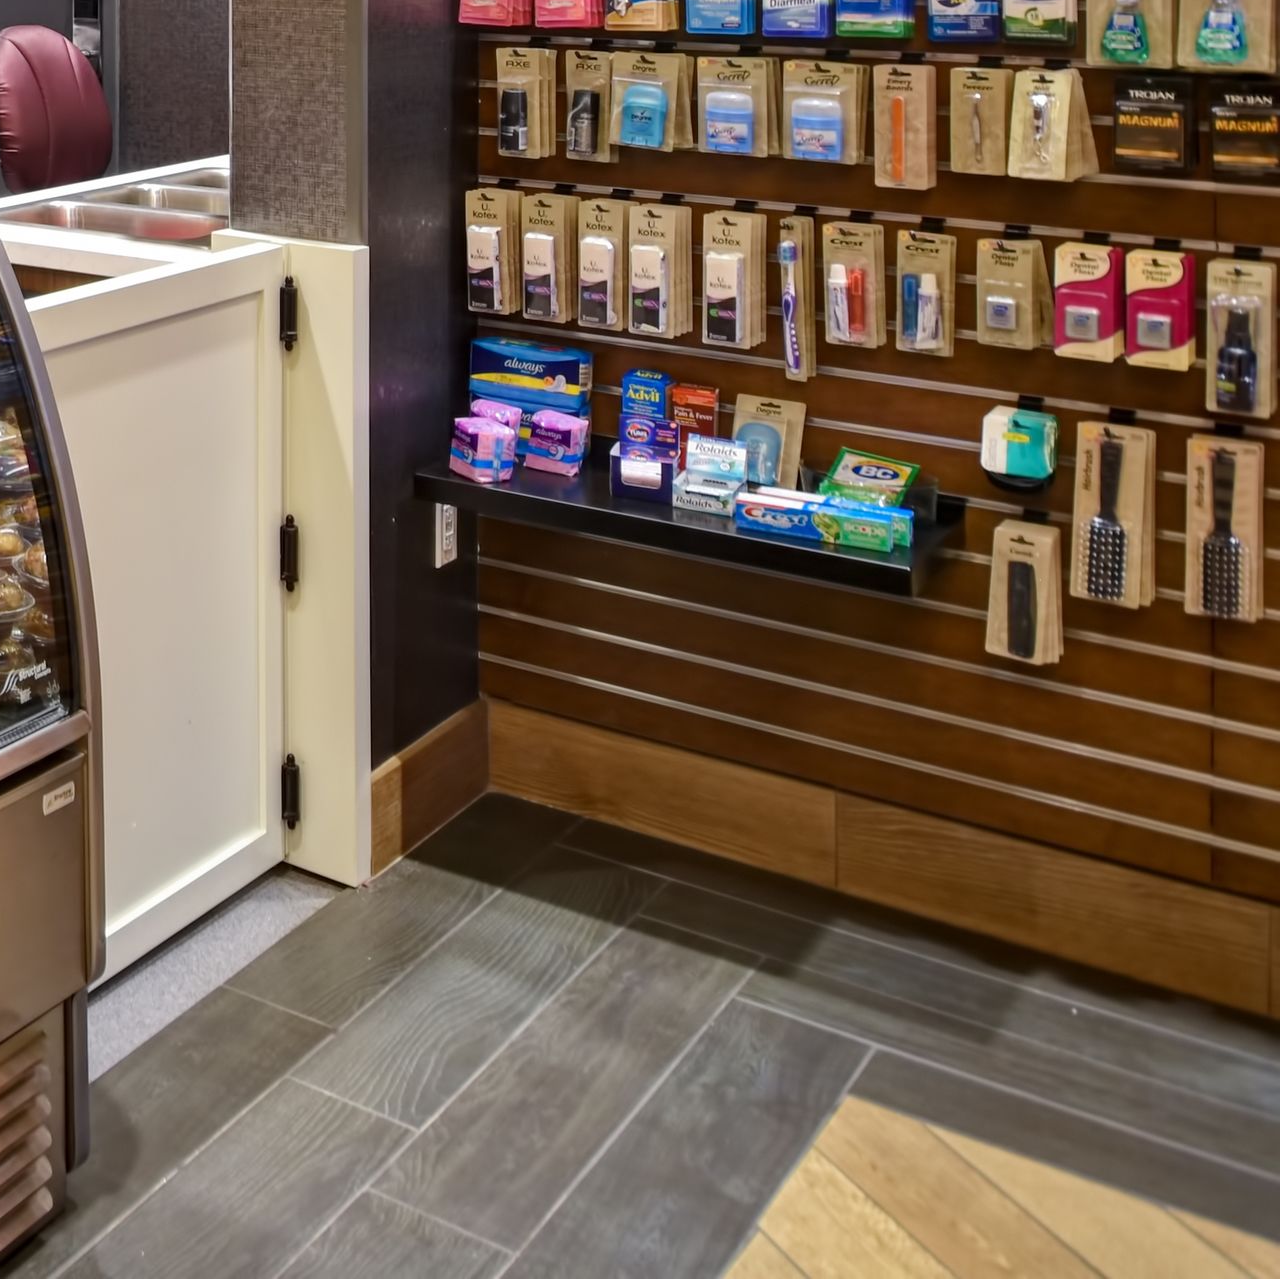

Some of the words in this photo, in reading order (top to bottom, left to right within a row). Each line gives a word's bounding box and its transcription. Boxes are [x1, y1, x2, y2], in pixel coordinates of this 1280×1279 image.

[505, 60, 531, 68] AXE
[576, 63, 602, 71] AXE
[632, 64, 657, 73] Degree
[717, 71, 751, 81] Secret
[804, 75, 840, 87] Secret
[1128, 89, 1175, 100] TROJAN
[1224, 94, 1273, 105] TROJAN
[1118, 114, 1179, 128] MAGNUM
[1215, 119, 1278, 133] MAGNUM
[830, 238, 864, 248] Crest
[905, 244, 940, 254] Crest
[504, 357, 546, 374] always
[626, 388, 660, 403] Advil
[756, 406, 782, 415] Degree
[695, 443, 738, 457] Rolaids
[859, 465, 894, 480] BC
[675, 495, 713, 509] Rolaids
[743, 505, 808, 527] Crest
[844, 523, 887, 537] scope
